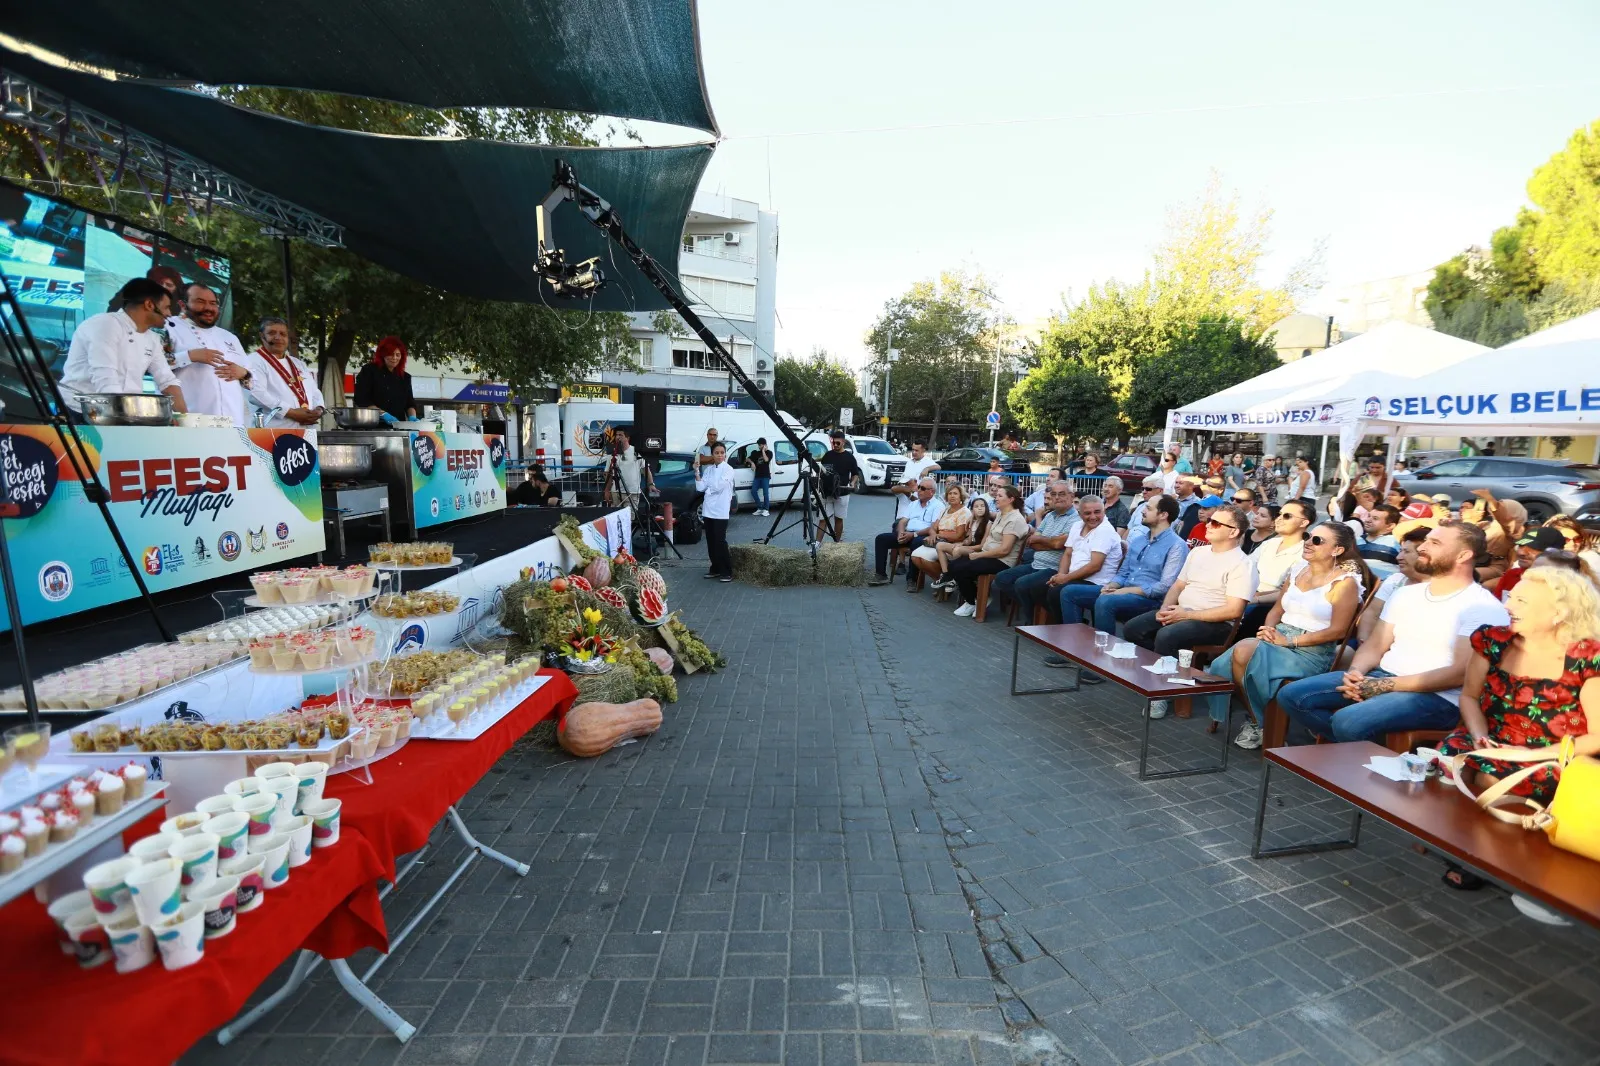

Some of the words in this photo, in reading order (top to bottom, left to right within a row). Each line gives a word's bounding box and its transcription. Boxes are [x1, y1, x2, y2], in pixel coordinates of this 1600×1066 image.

[1183, 414, 1228, 427] SELÇUK
[1232, 407, 1317, 424] BELEDİYESİ
[1387, 394, 1499, 419] SELÇUK
[1510, 388, 1600, 413] BELE
[279, 442, 311, 475] efest
[446, 449, 485, 472] EFEST
[107, 456, 252, 503] EFEST
